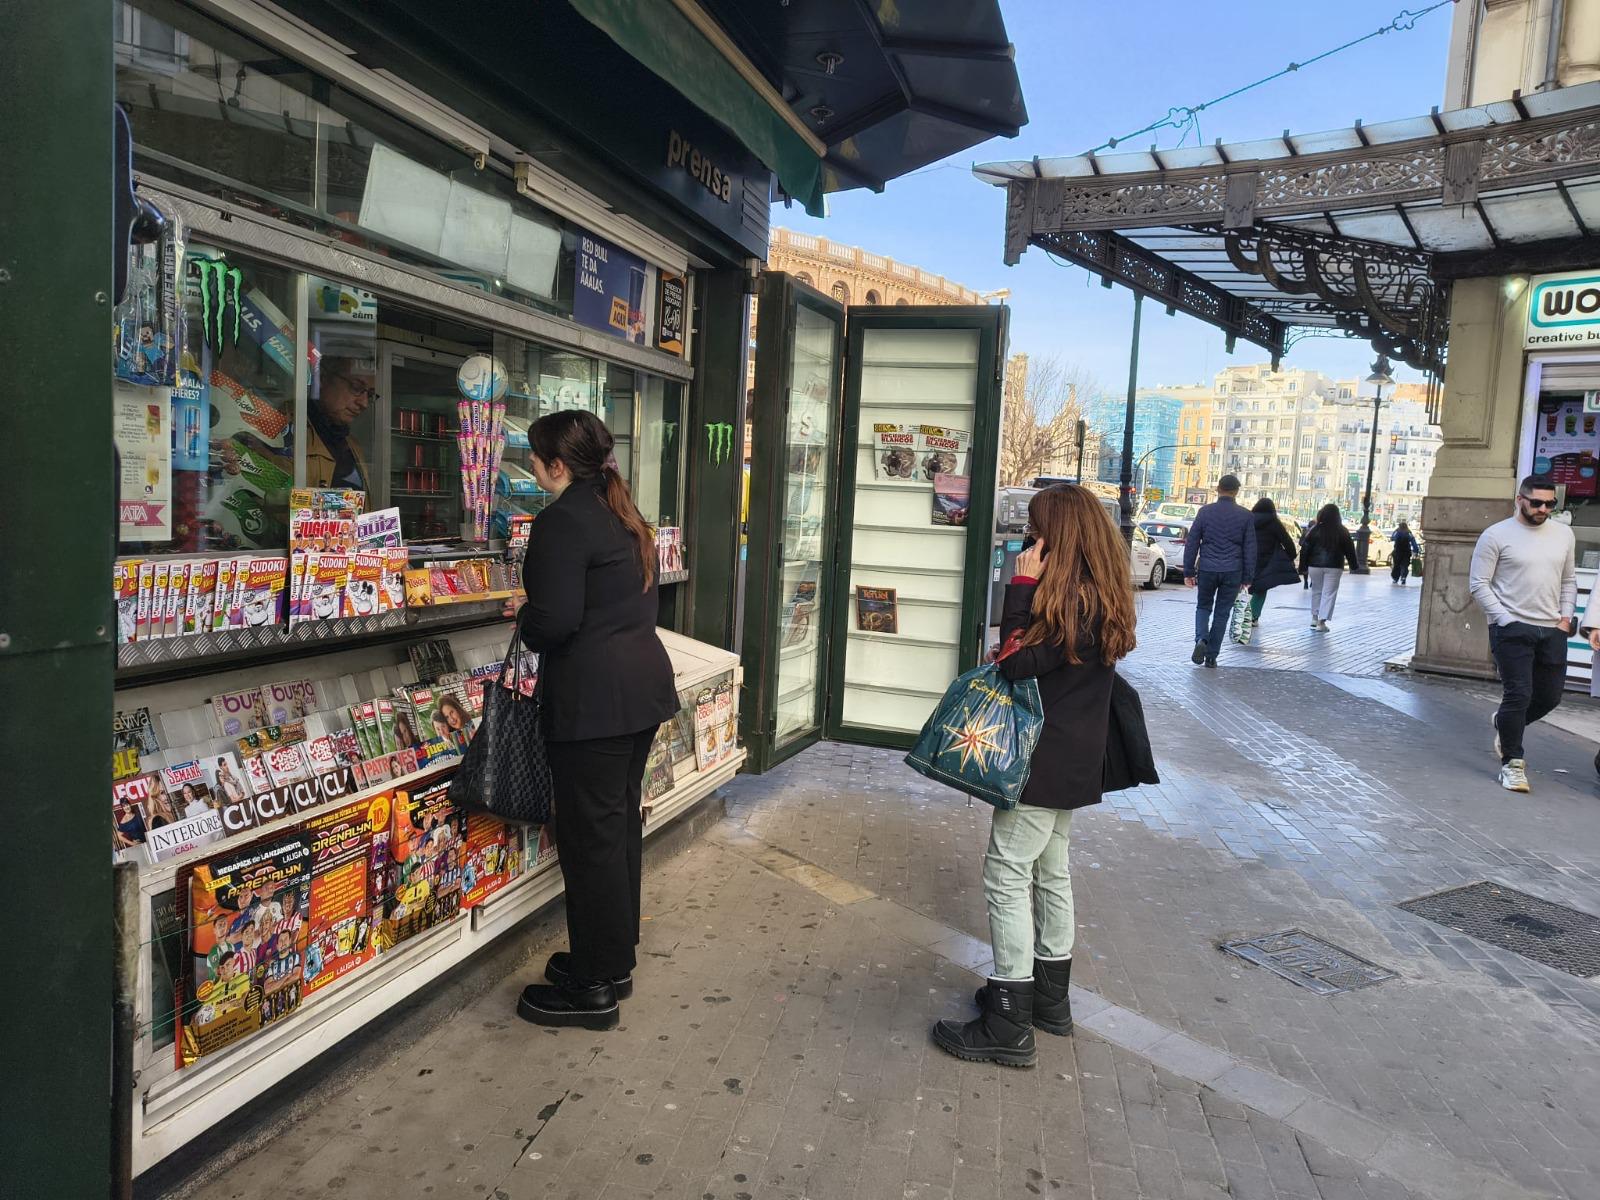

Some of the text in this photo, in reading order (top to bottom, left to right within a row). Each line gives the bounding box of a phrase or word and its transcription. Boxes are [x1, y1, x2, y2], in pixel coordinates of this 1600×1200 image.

[667, 129, 732, 203] prensa
[582, 236, 608, 263] RED BULL
[582, 253, 598, 274] TE DA
[164, 240, 176, 322] MINECRAFT
[580, 272, 605, 295] AAALAS.
[1528, 332, 1583, 344] creative
[319, 557, 348, 569] SUDOKU
[356, 556, 383, 567] SUDOKU
[387, 548, 408, 560] SUDOKU
[249, 559, 287, 574] SUDOKU
[863, 589, 889, 601] Teruel
[271, 679, 314, 704] burda
[270, 747, 299, 765] Cosas
[279, 757, 301, 772] casa
[165, 761, 202, 785] SEMANA
[175, 843, 194, 855] CASA
[260, 841, 301, 860] LANZAMIENTO
